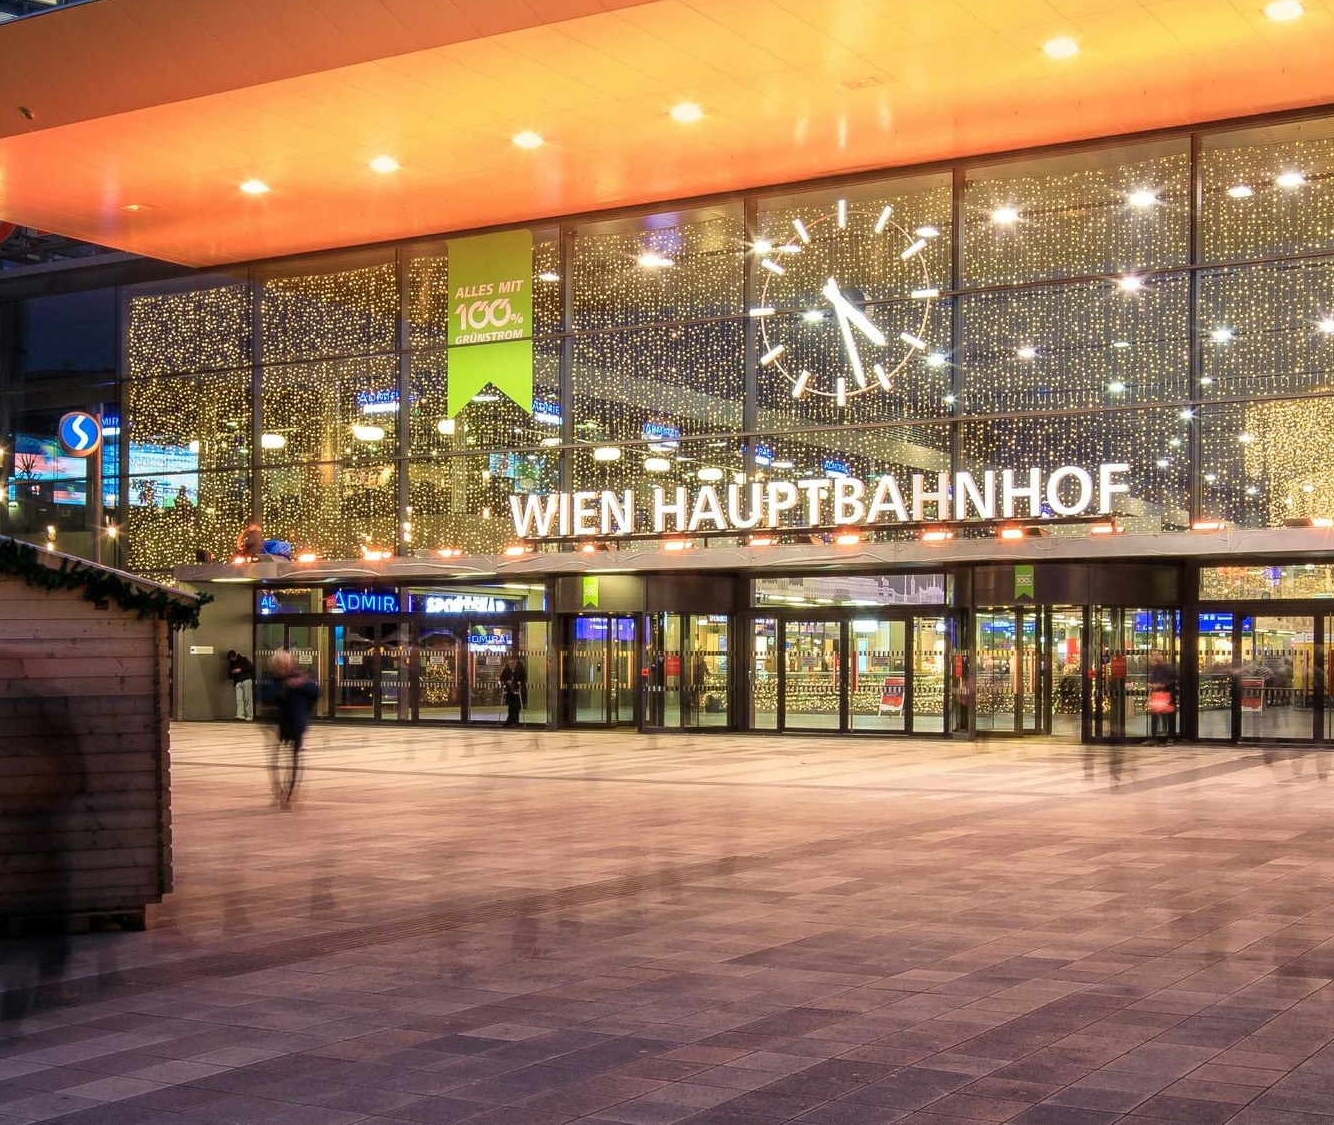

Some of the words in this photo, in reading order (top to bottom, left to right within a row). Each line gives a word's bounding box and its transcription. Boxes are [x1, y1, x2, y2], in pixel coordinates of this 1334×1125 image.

[455, 283, 494, 299] ALLES
[498, 279, 524, 294] MIT
[454, 298, 524, 331] 100%
[455, 329, 524, 345] GRÜNSTROM
[509, 489, 635, 537] WIEN
[654, 463, 1131, 529] HAUPTBAHNHOF
